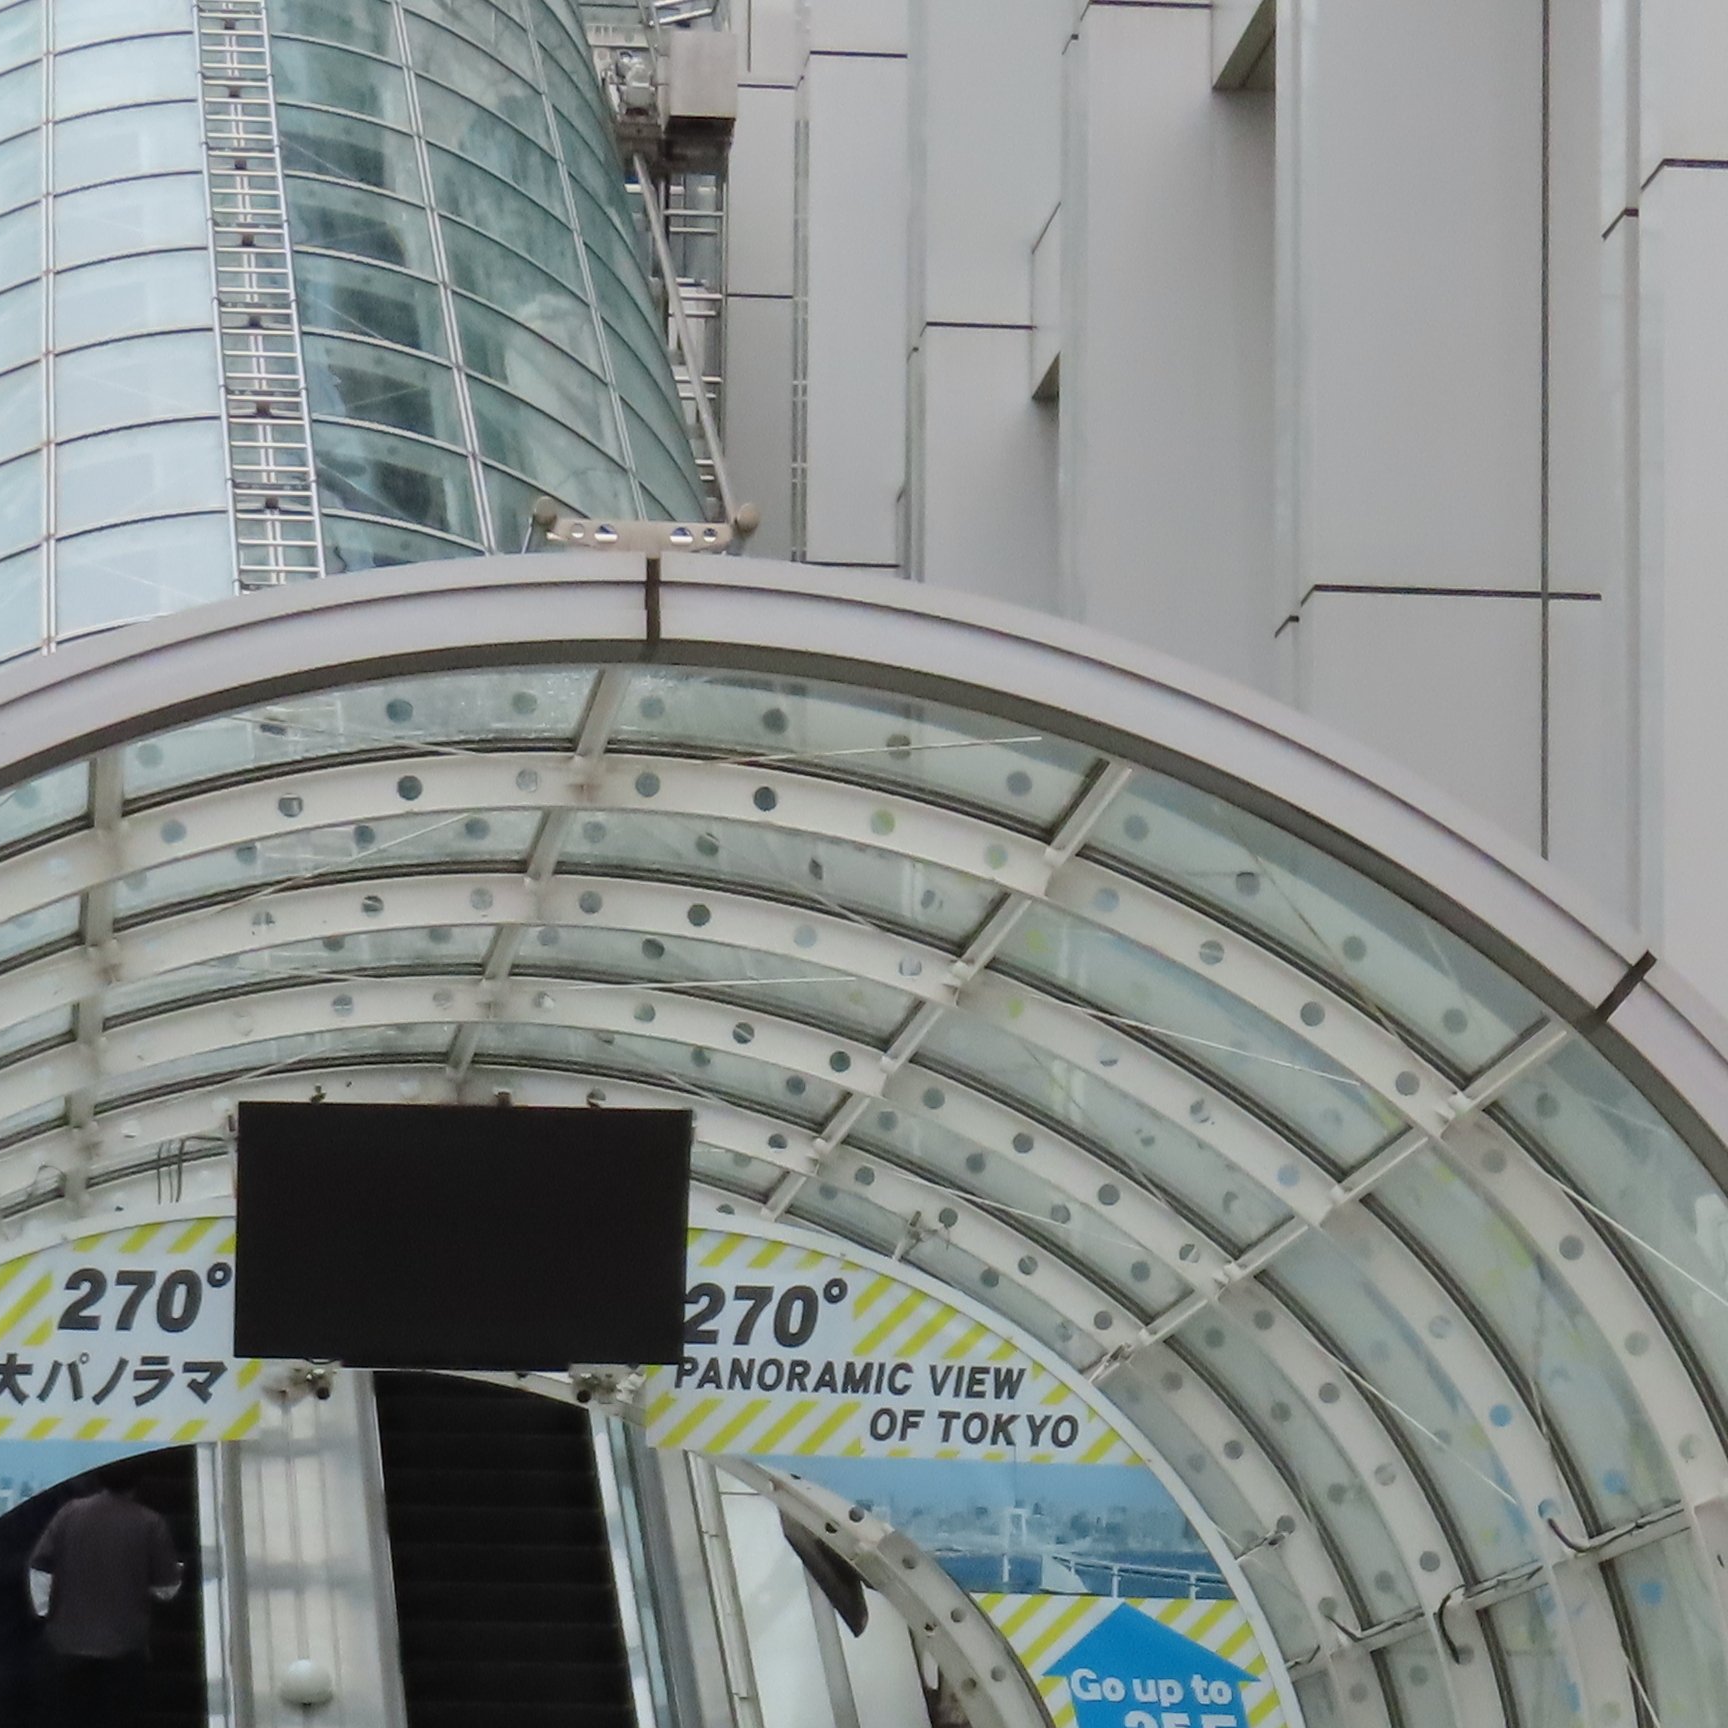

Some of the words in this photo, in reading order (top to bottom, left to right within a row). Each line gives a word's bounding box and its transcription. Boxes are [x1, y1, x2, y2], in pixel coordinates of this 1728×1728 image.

[57, 1261, 233, 1334] 270°
[673, 1356, 915, 1396] PANORAMIC
[929, 1364, 1027, 1401] VIEW
[870, 1408, 926, 1443] OF
[938, 1410, 1081, 1449] TOKYO
[1071, 1668, 1126, 1702] Go
[1132, 1677, 1185, 1708] up
[1190, 1674, 1234, 1705] to
